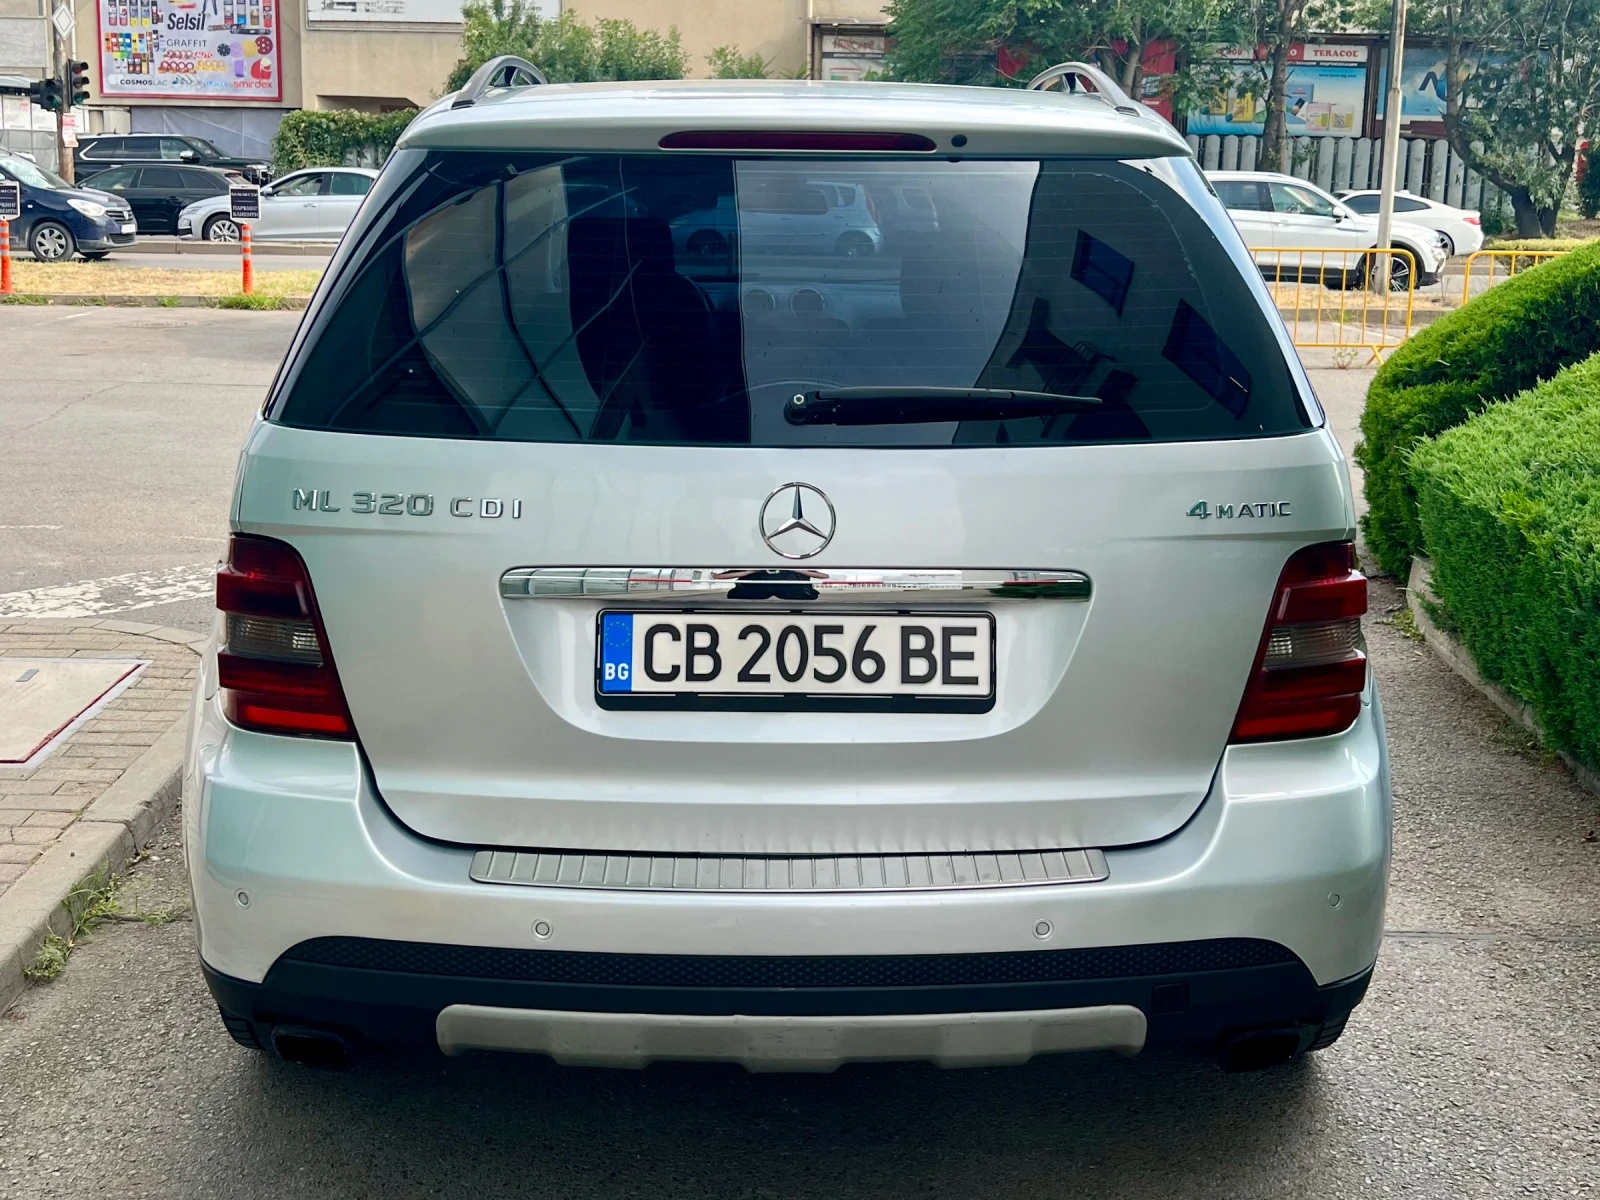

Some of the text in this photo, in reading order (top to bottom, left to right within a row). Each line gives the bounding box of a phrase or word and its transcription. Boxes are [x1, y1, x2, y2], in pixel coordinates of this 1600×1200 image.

[167, 12, 206, 31] Selsil
[166, 38, 207, 47] GRAFFIT
[1313, 49, 1359, 57] TERACOL
[119, 78, 168, 86] COSMOSLAC
[233, 79, 273, 88] smirdex
[292, 488, 341, 513] ML
[351, 490, 434, 516] 320
[643, 623, 979, 686] CB 2056 BE
[604, 662, 630, 681] BG
